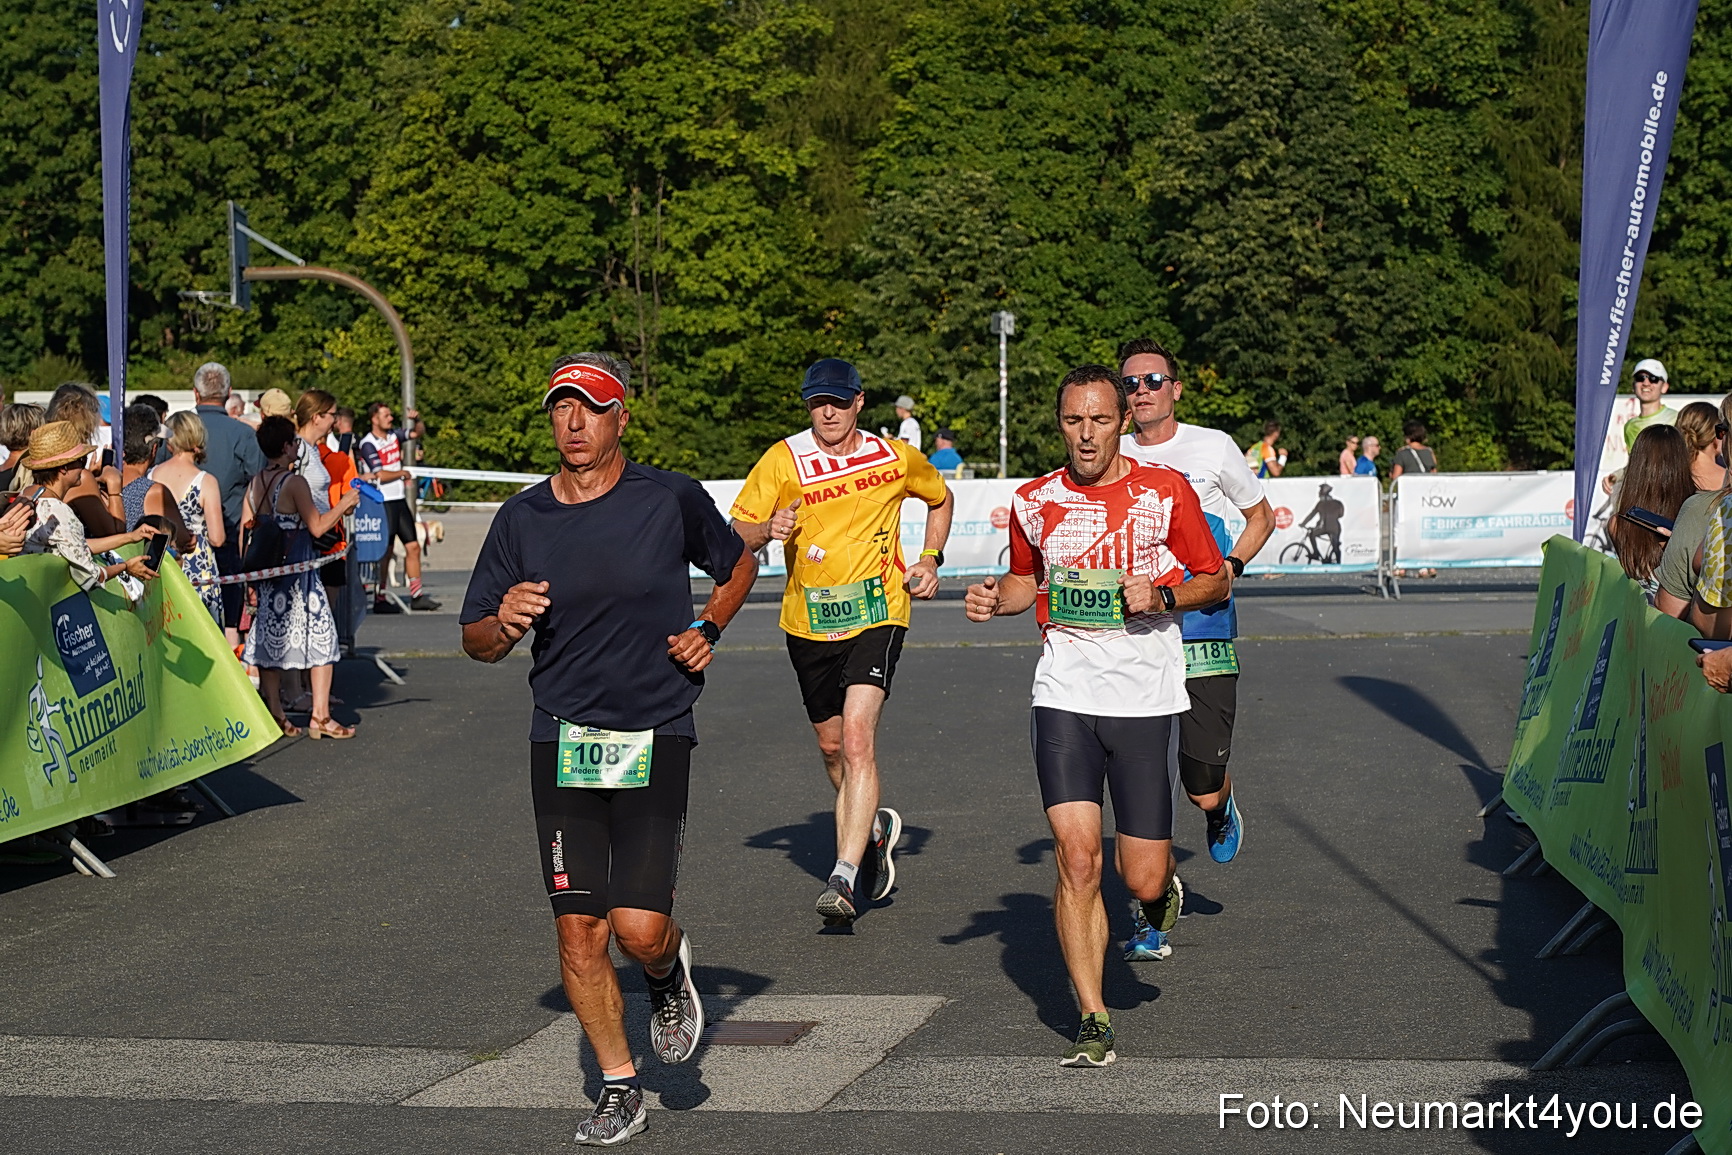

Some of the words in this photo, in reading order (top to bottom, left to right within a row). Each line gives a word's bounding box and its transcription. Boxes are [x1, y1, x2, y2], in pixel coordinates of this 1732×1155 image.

[1600, 70, 1668, 386] www.fischer-automobile.de
[803, 483, 850, 506] MAX
[854, 468, 905, 491] BÖGL
[1421, 495, 1457, 508] NOW
[355, 513, 382, 532] scher
[1423, 518, 1473, 530] E-BIKES
[1475, 518, 1485, 529] &
[1488, 514, 1567, 528] FAHRRÄDER
[821, 601, 852, 617] 800
[1060, 587, 1111, 609] 1099
[811, 607, 819, 624] RUN
[838, 615, 861, 624] Andreas
[858, 599, 868, 621] 2022
[1057, 606, 1078, 616] Pürzer
[62, 623, 94, 648] Fischer
[72, 639, 97, 657] AUTOMOBILE
[1188, 642, 1228, 661] 1181
[60, 653, 146, 752] firmenlauf
[79, 735, 117, 774] neumarkt
[563, 750, 572, 773] RUN
[574, 743, 636, 765] 1087
[637, 748, 648, 778] 2022
[570, 767, 602, 775] Mederer
[555, 830, 565, 872] SWITZERLAND
